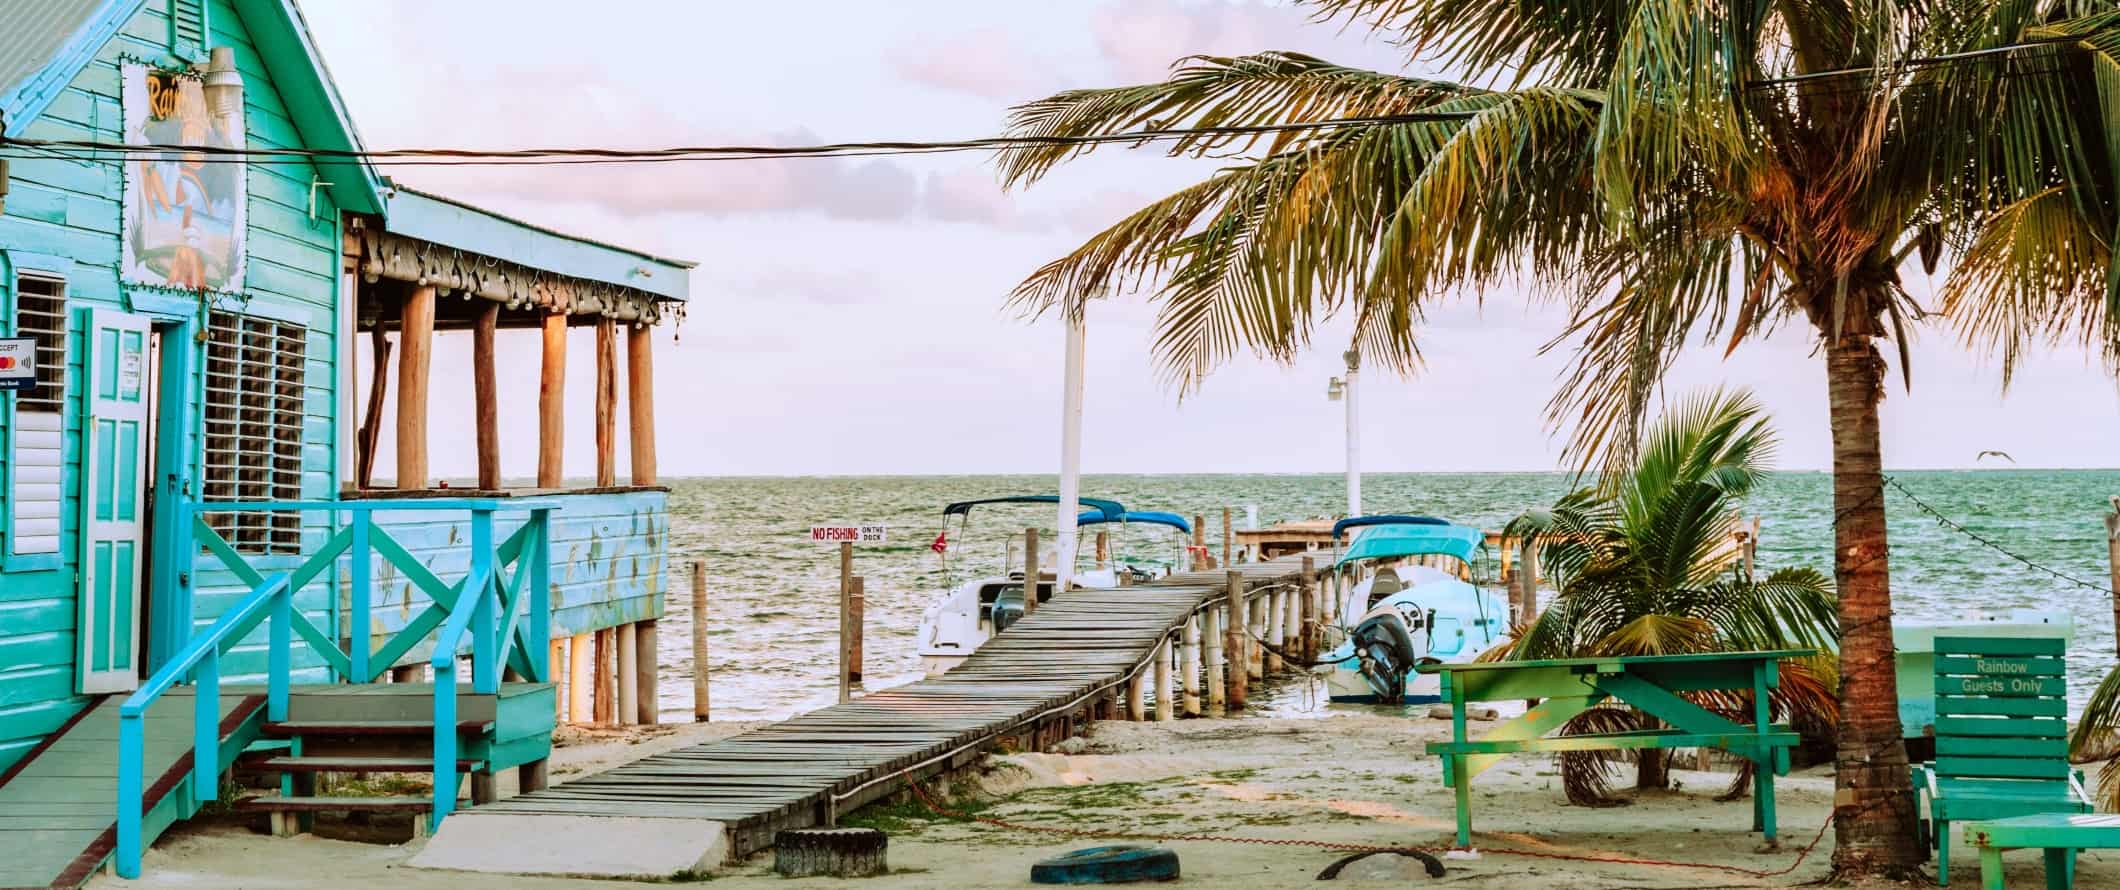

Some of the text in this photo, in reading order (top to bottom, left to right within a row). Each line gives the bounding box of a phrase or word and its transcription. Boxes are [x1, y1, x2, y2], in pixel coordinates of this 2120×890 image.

[813, 528, 858, 540] NO FISHING
[1977, 660, 2027, 673] Rainbow
[1962, 679, 2042, 694] Guests Only
